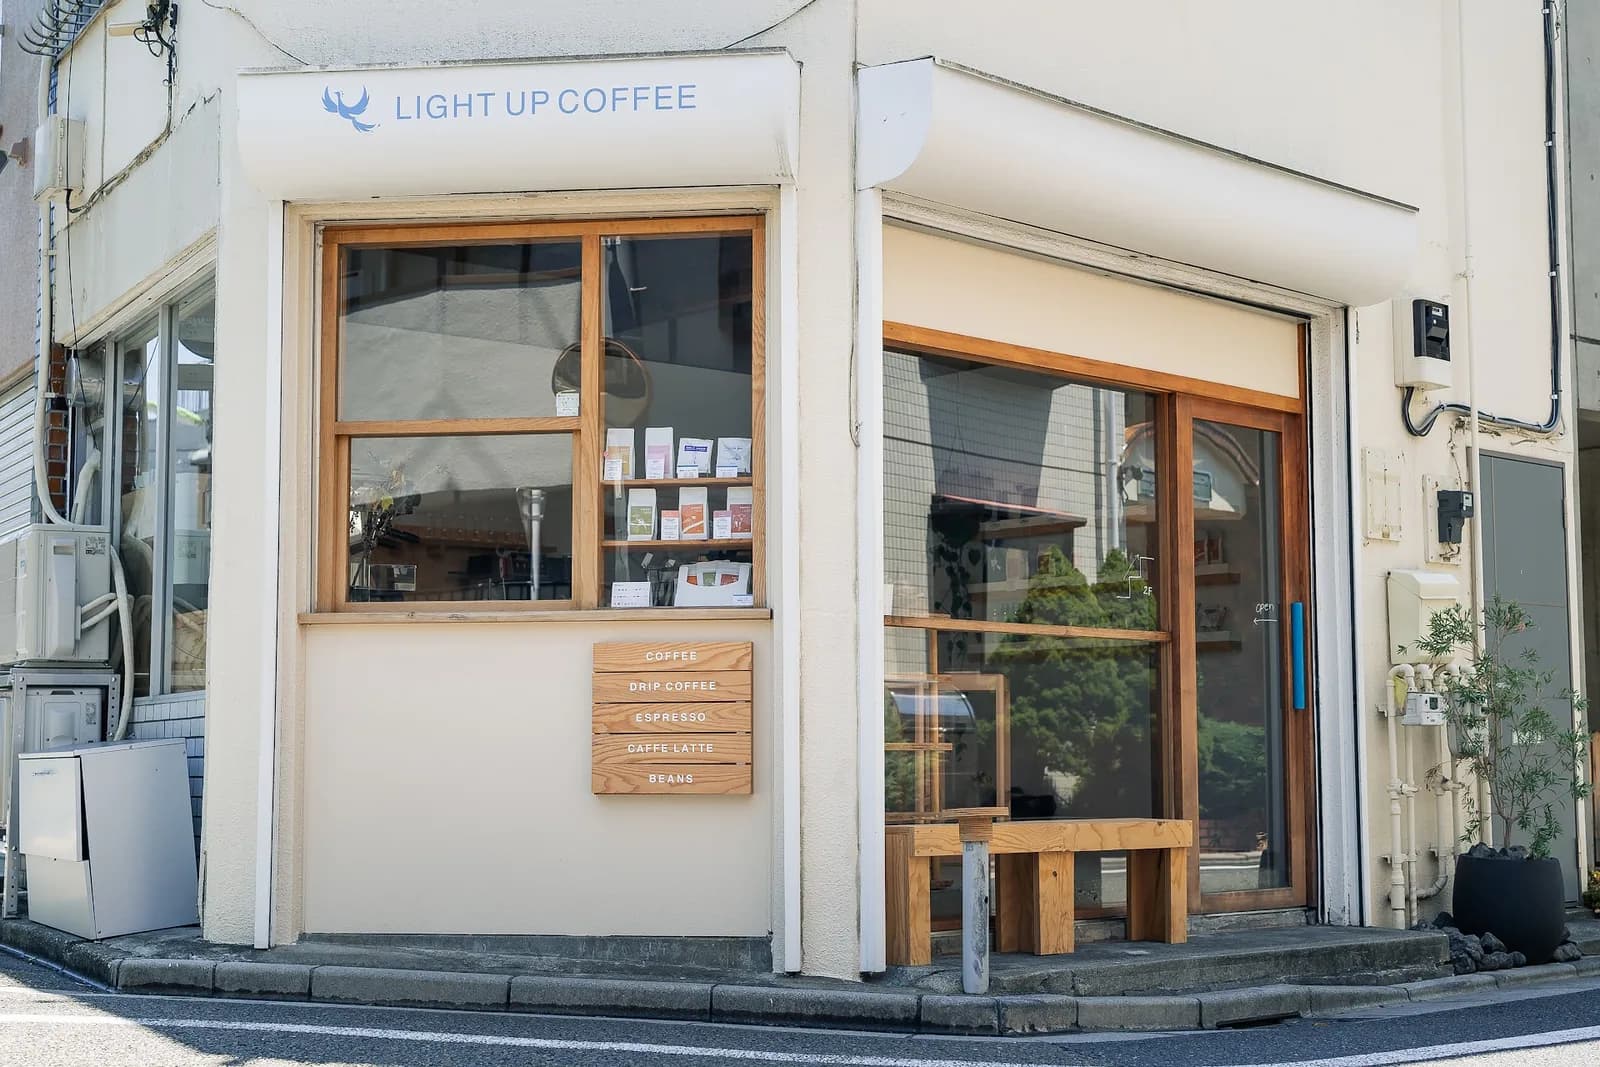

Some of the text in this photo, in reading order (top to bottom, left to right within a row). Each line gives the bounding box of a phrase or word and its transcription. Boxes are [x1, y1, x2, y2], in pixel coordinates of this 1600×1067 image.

[396, 84, 697, 120] LIGHT UP COFFEE
[1143, 585, 1153, 596] 2F
[646, 651, 697, 661] COFFEE
[629, 681, 717, 691] DRIP COFFEE
[635, 712, 706, 722] ESPRESSO
[627, 743, 714, 753] CAFFE LATTE
[649, 774, 694, 783] BEANS
